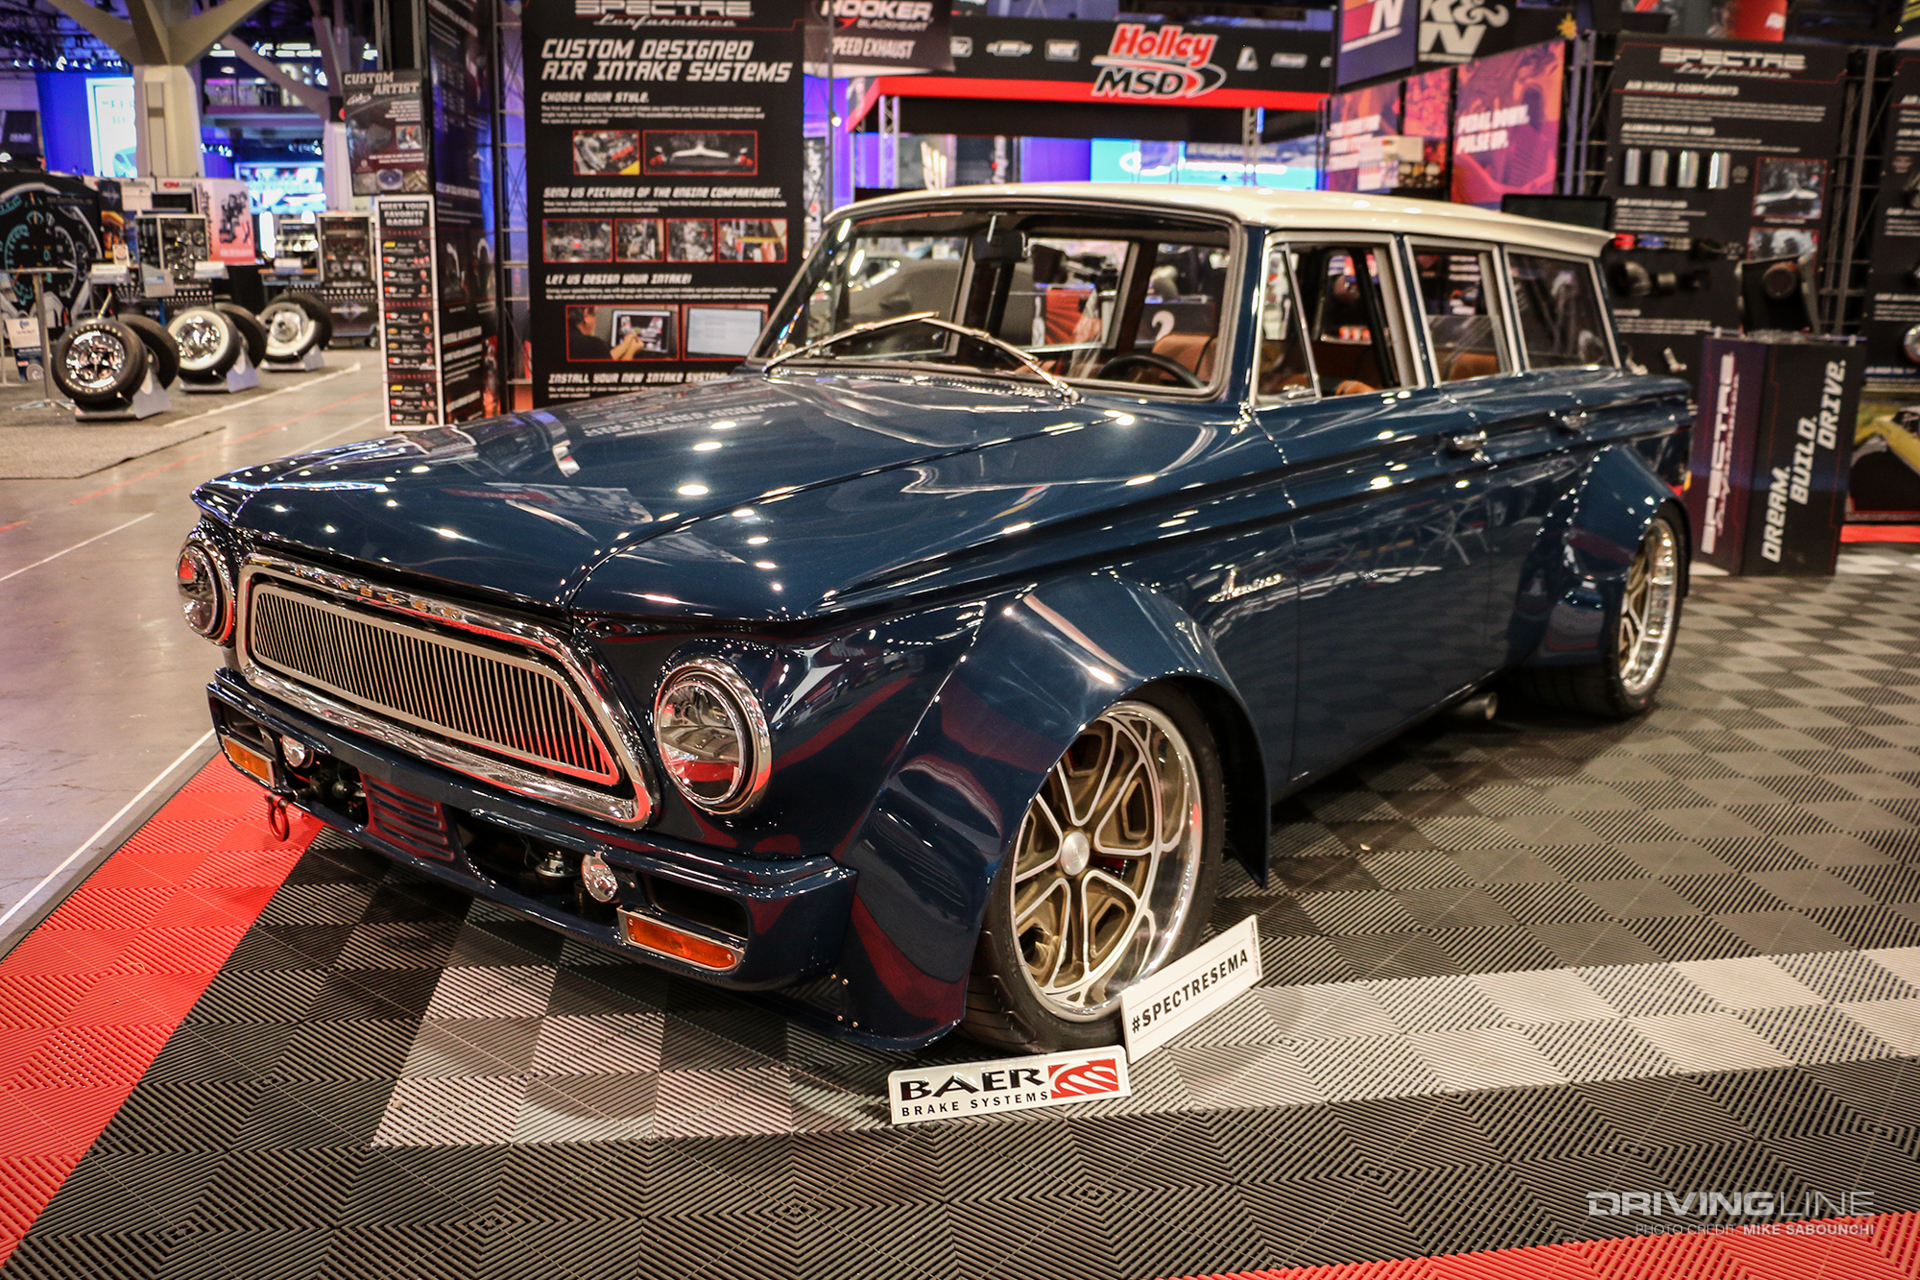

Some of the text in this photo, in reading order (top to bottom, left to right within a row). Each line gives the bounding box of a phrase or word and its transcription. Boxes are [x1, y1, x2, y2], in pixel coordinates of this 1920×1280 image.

[575, 0, 750, 17] SPECTRE
[541, 39, 635, 59] CUSTOM
[826, 36, 916, 60] PEED EXHAUST
[1109, 24, 1219, 70] Holley
[1660, 47, 1807, 70] SPECTRE
[344, 71, 394, 85] CUSTOM
[541, 60, 793, 83] AIR INTAKE SYSTEMS
[1091, 66, 1186, 99] MSD
[373, 82, 420, 95] ARTIST
[541, 92, 650, 103] CHOOSE YOUR STYLE.
[545, 274, 565, 285] LET
[566, 274, 581, 285] US
[548, 373, 590, 384] INSTALL
[592, 373, 620, 384] YOUR
[621, 372, 645, 383] NEW
[646, 372, 684, 383] INTAKE
[1817, 360, 1847, 450] DRIVE.
[1789, 416, 1818, 505] BUILD.
[1761, 466, 1791, 563] DREAM.
[1131, 949, 1249, 1033] #SPECTRESEMA
[901, 1068, 1045, 1100] BAER
[901, 1091, 1049, 1117] BRAKE SYSTEMS
